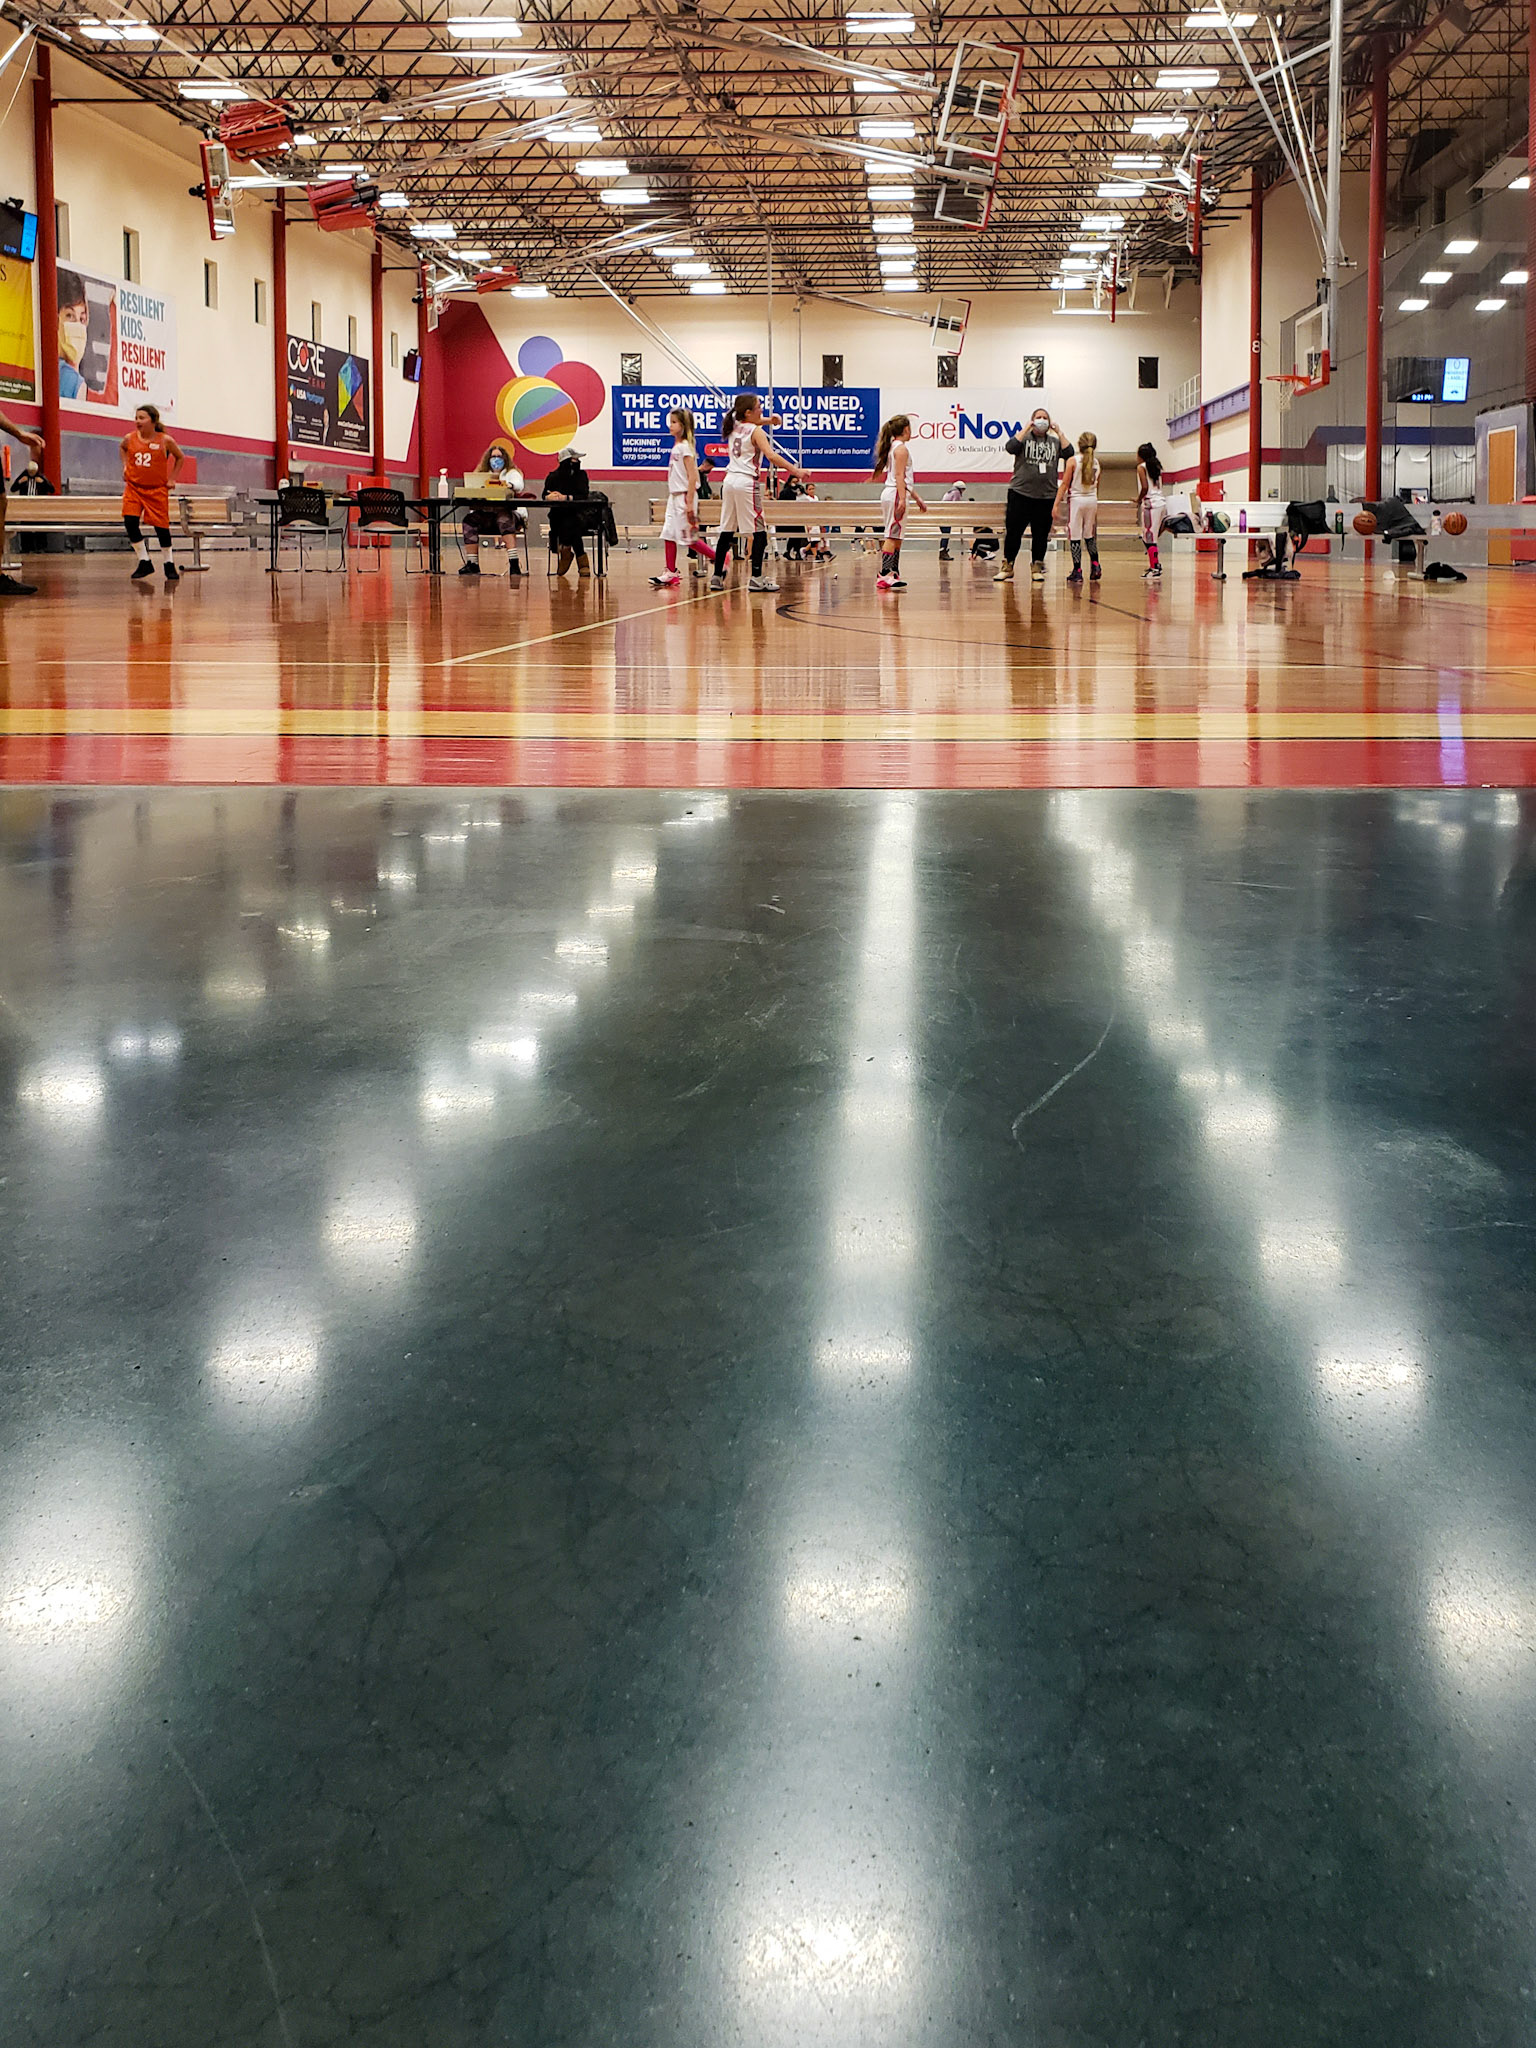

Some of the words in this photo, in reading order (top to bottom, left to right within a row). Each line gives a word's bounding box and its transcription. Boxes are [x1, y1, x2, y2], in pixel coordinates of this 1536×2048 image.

[120, 289, 164, 322] RESILIENT
[120, 315, 146, 342] KIDS.
[121, 341, 166, 371] RESILIENT
[1252, 340, 1260, 353] 8
[288, 338, 326, 378] CORE
[122, 366, 149, 392] CARE.
[621, 393, 655, 409] THE
[658, 393, 774, 410] CONVENICE
[778, 395, 812, 410] YOU
[816, 395, 863, 413] NEED,
[622, 411, 661, 429] THE
[665, 411, 717, 429] RE
[622, 438, 661, 446] MCKINNEY
[959, 445, 983, 453] Medical
[984, 445, 997, 454] City
[134, 452, 151, 468] 32
